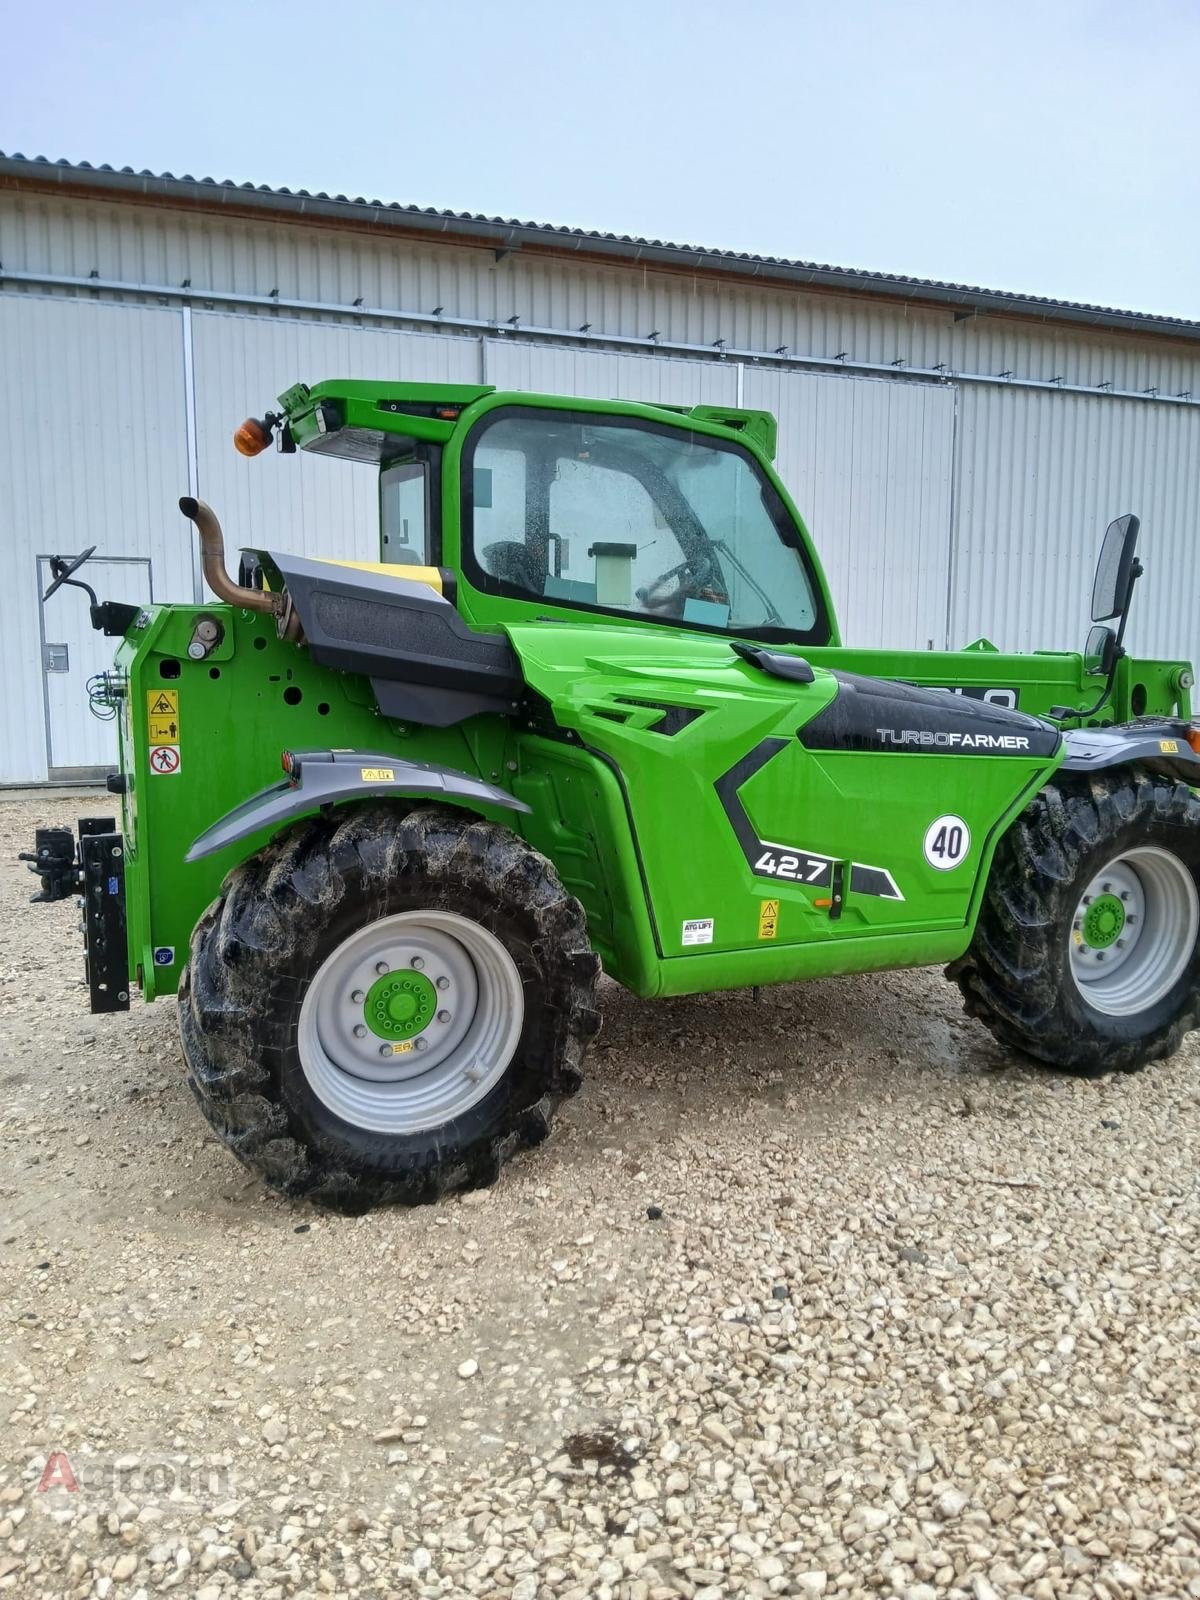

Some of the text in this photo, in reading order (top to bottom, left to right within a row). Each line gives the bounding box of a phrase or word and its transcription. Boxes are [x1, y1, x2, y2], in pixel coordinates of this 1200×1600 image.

[876, 728, 1030, 750] TURBOFARMER
[932, 825, 963, 859] 40
[754, 851, 828, 882] 42.7
